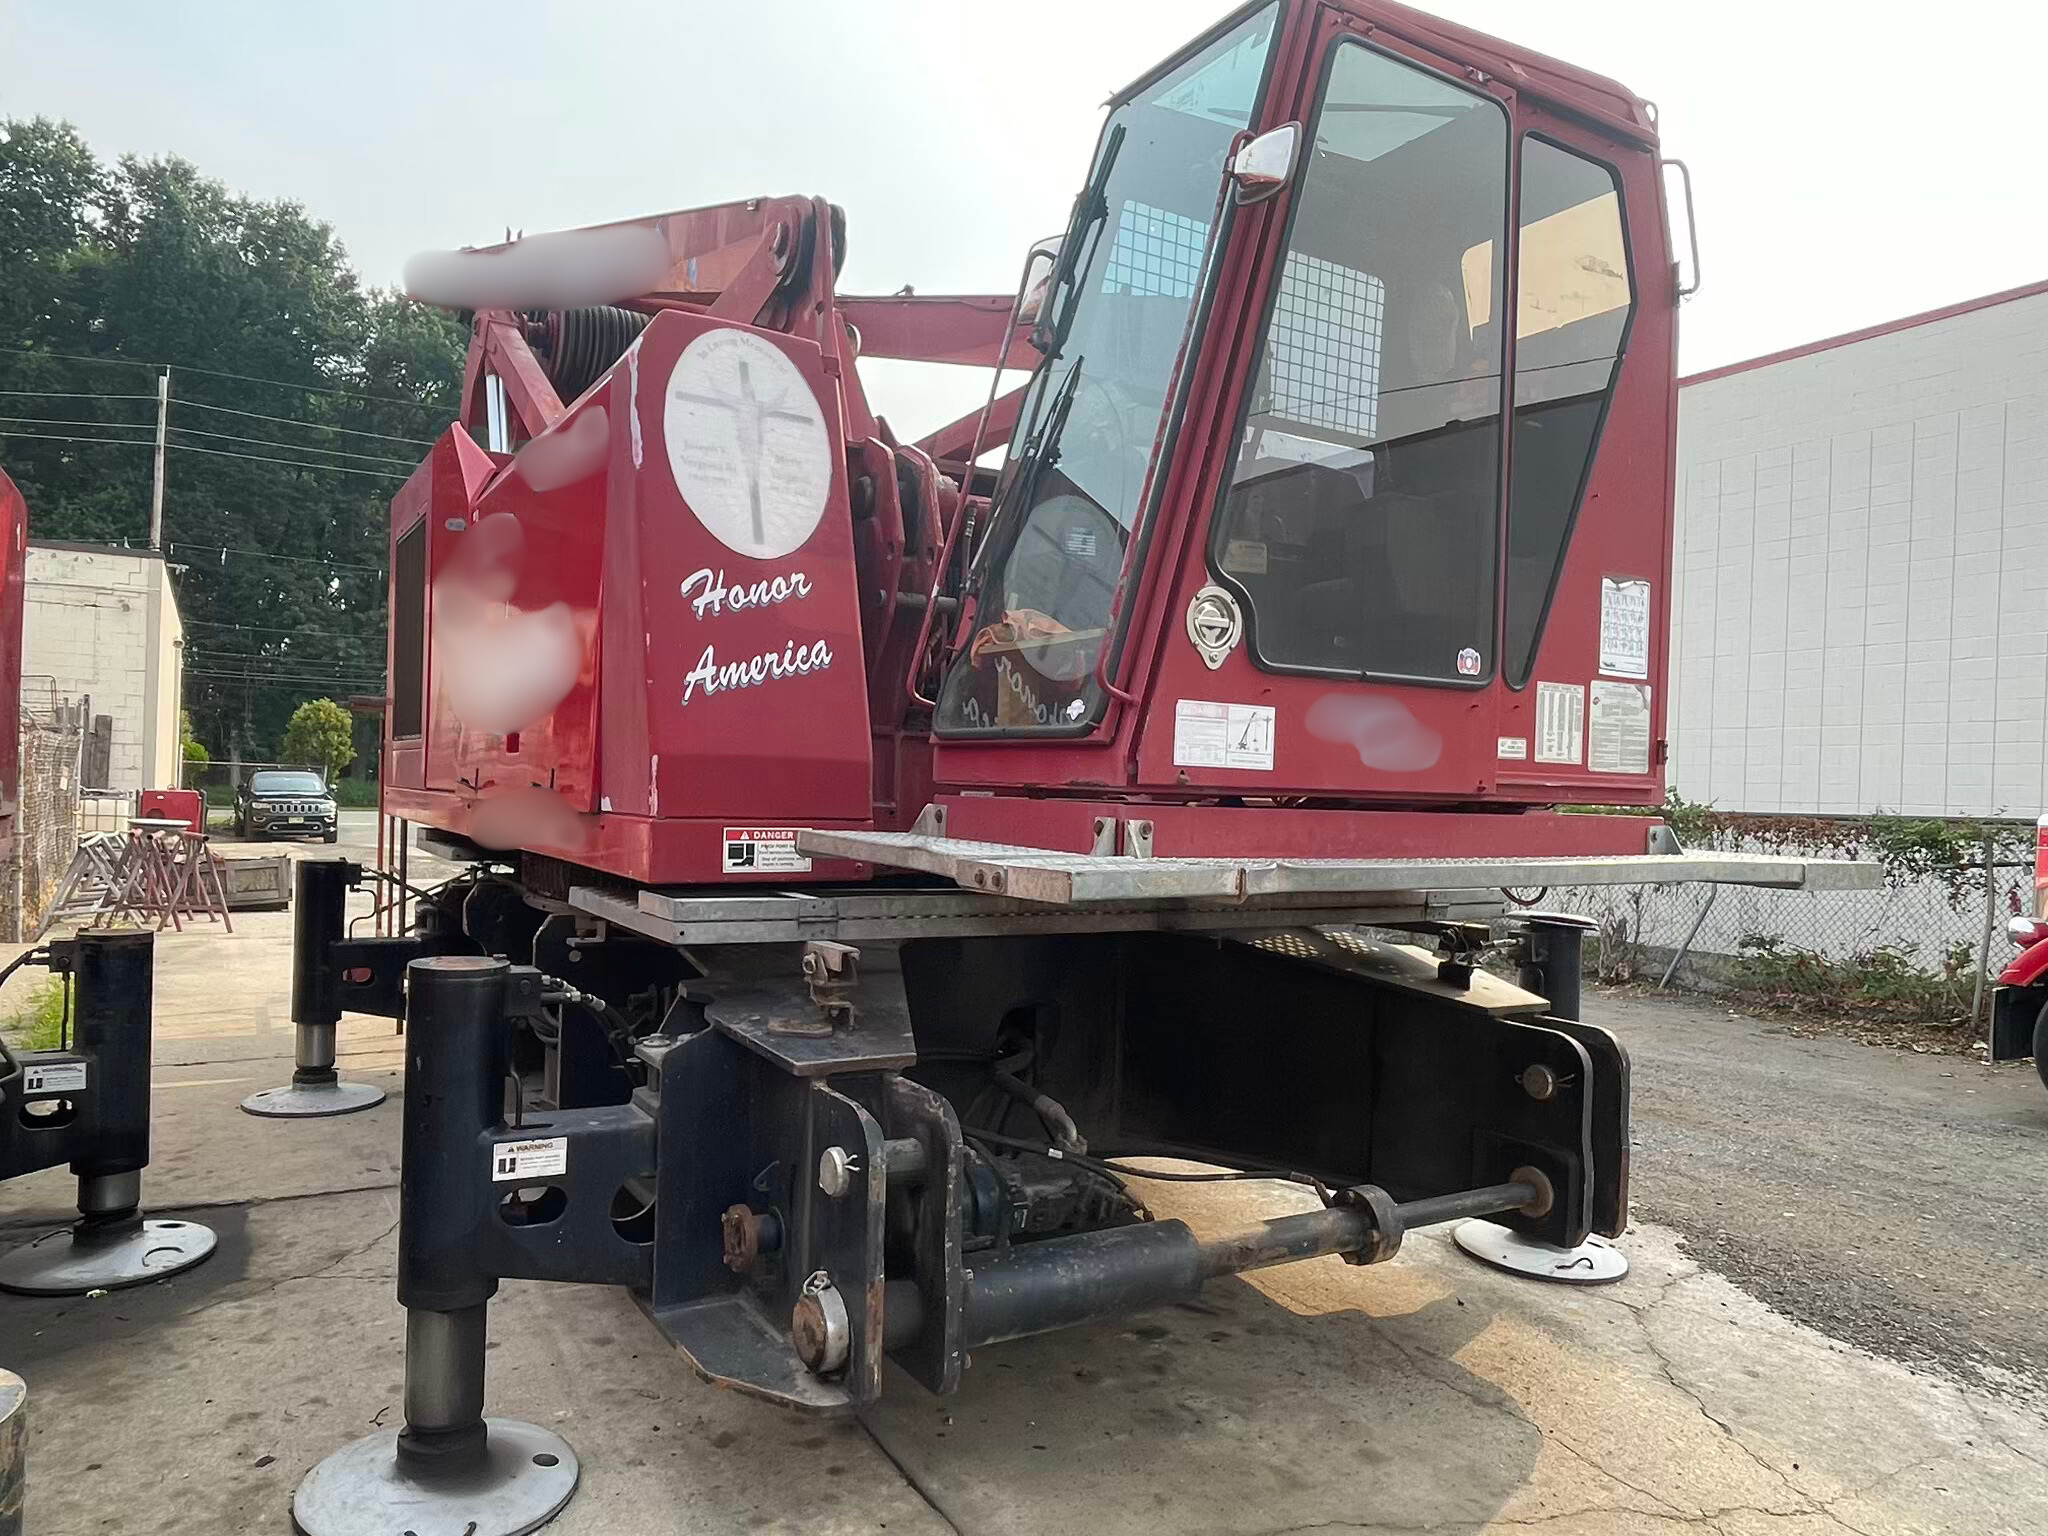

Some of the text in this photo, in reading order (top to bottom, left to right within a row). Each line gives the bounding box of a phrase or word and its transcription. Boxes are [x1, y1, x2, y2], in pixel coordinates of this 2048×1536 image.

[680, 568, 813, 620] Honor
[681, 639, 833, 706] America
[753, 830, 794, 840] DANGER
[516, 1141, 554, 1152] WARNING
